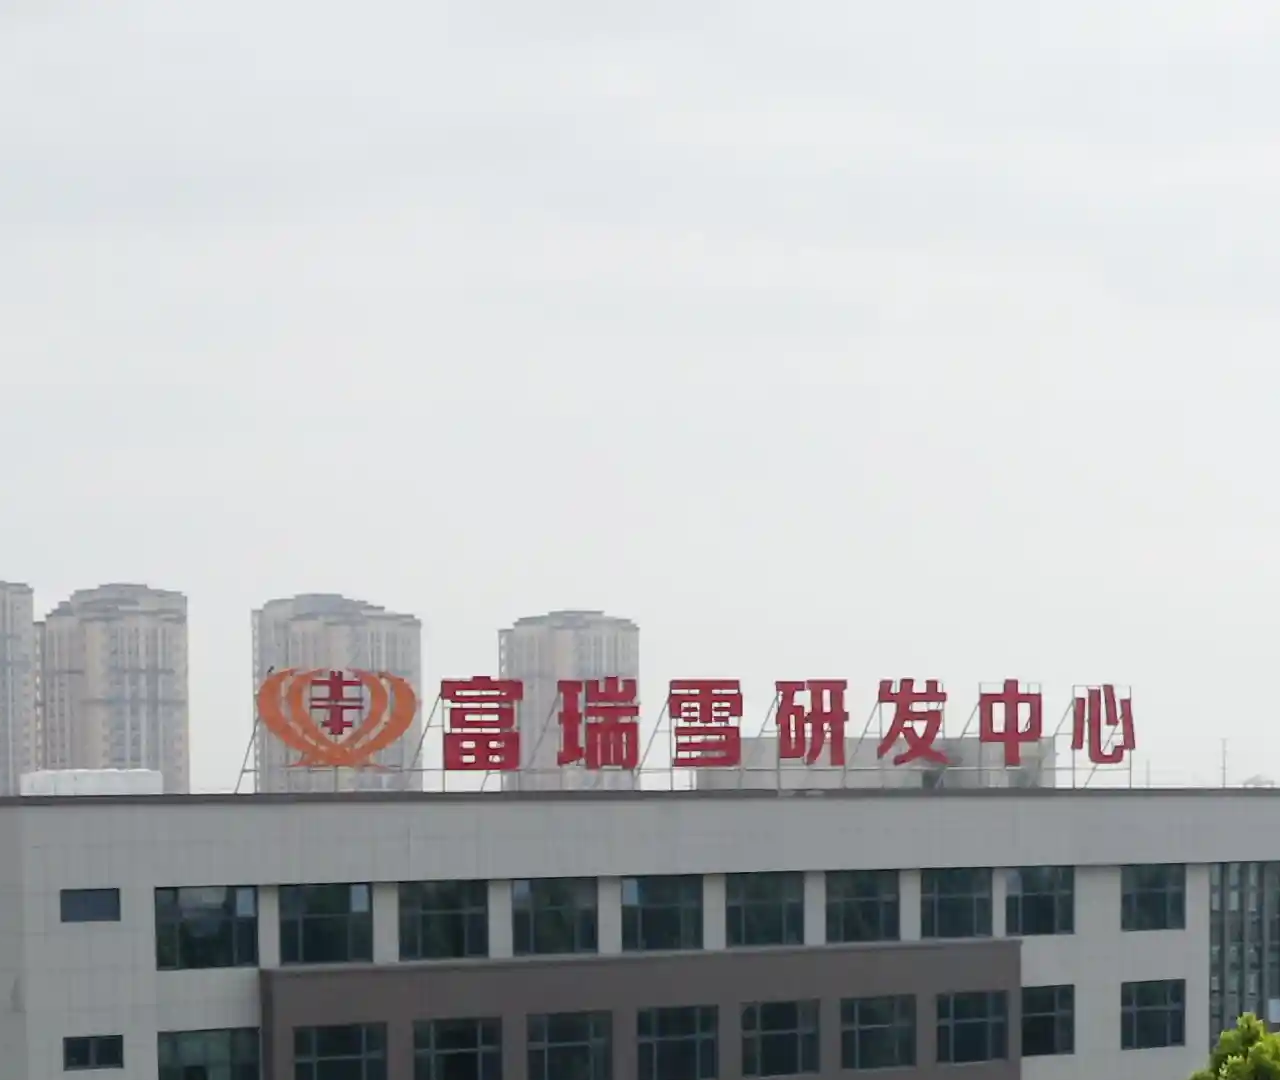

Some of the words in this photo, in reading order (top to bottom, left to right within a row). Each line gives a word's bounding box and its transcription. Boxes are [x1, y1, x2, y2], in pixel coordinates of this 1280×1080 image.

[441, 676, 1136, 770] 富瑞雪研发中心
